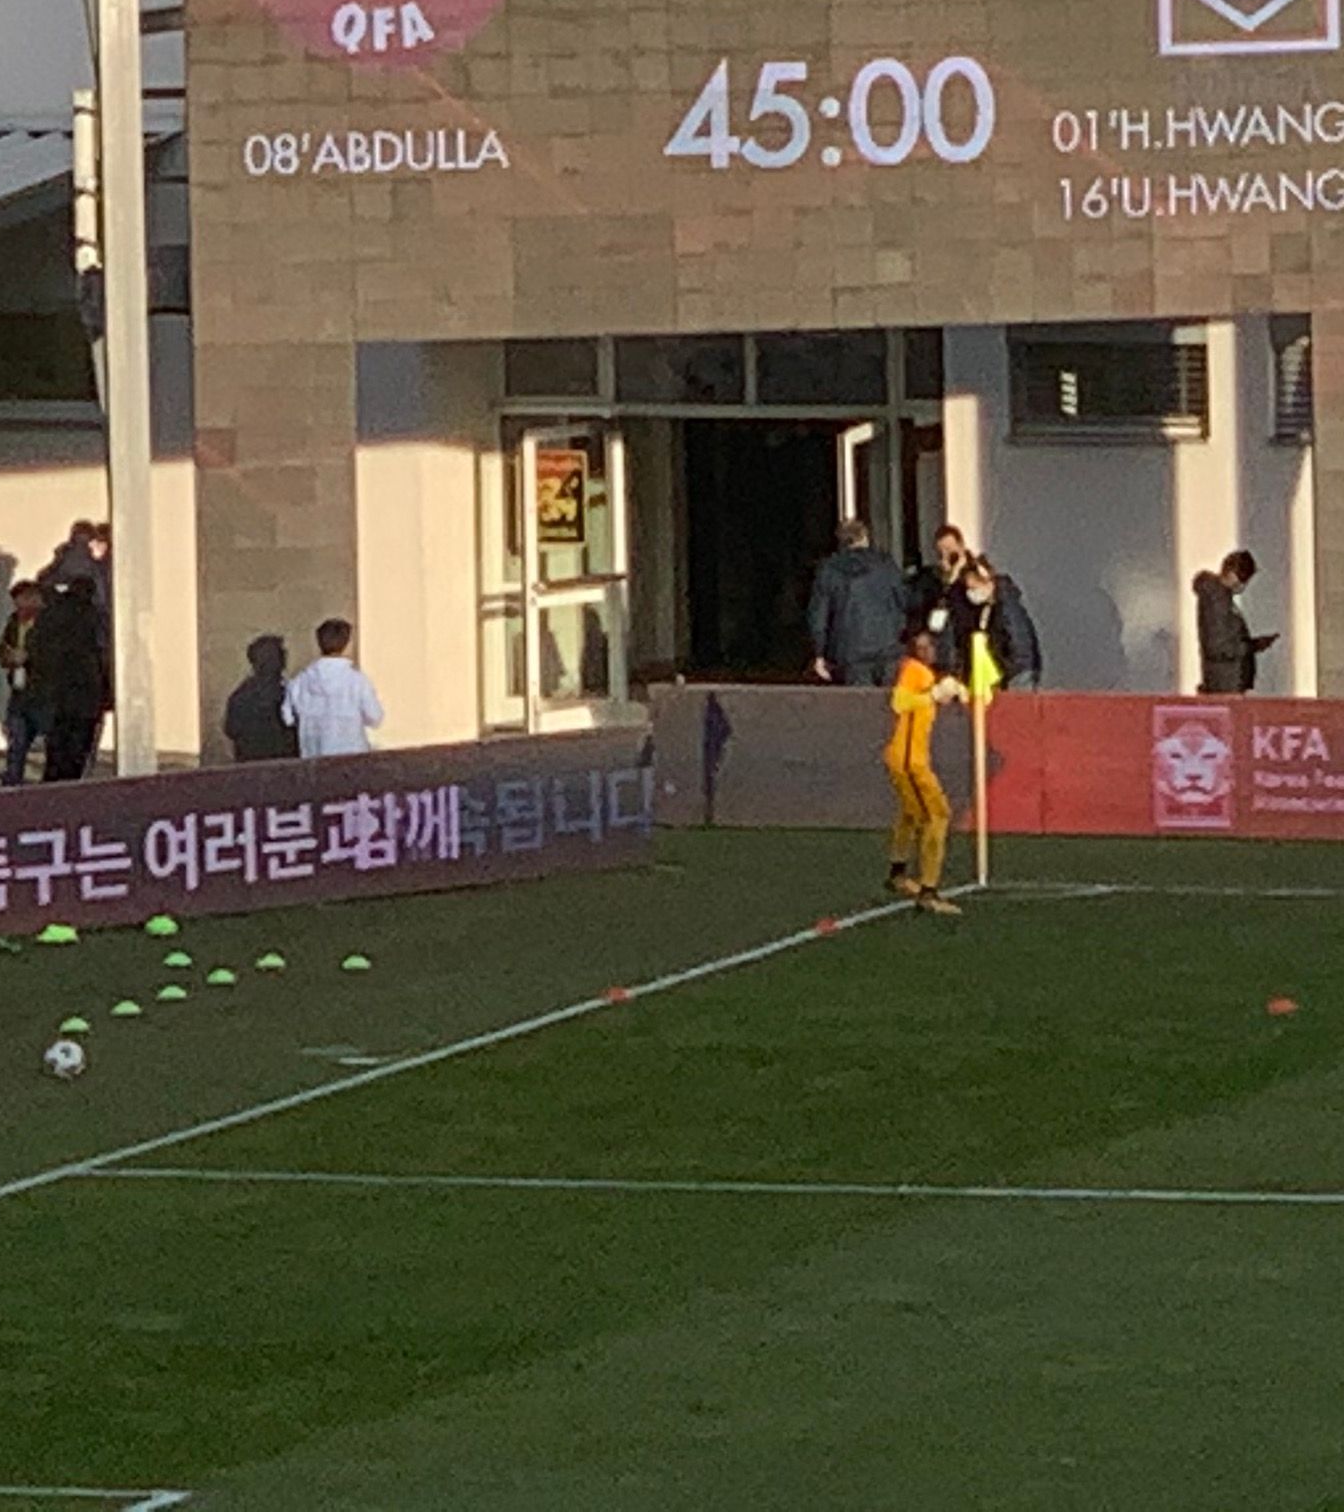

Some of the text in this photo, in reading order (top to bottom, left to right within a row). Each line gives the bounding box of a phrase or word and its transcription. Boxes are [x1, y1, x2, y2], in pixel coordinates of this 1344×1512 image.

[331, 1, 436, 54] QFA
[662, 55, 996, 169] 45:00
[1252, 725, 1331, 762] KFA
